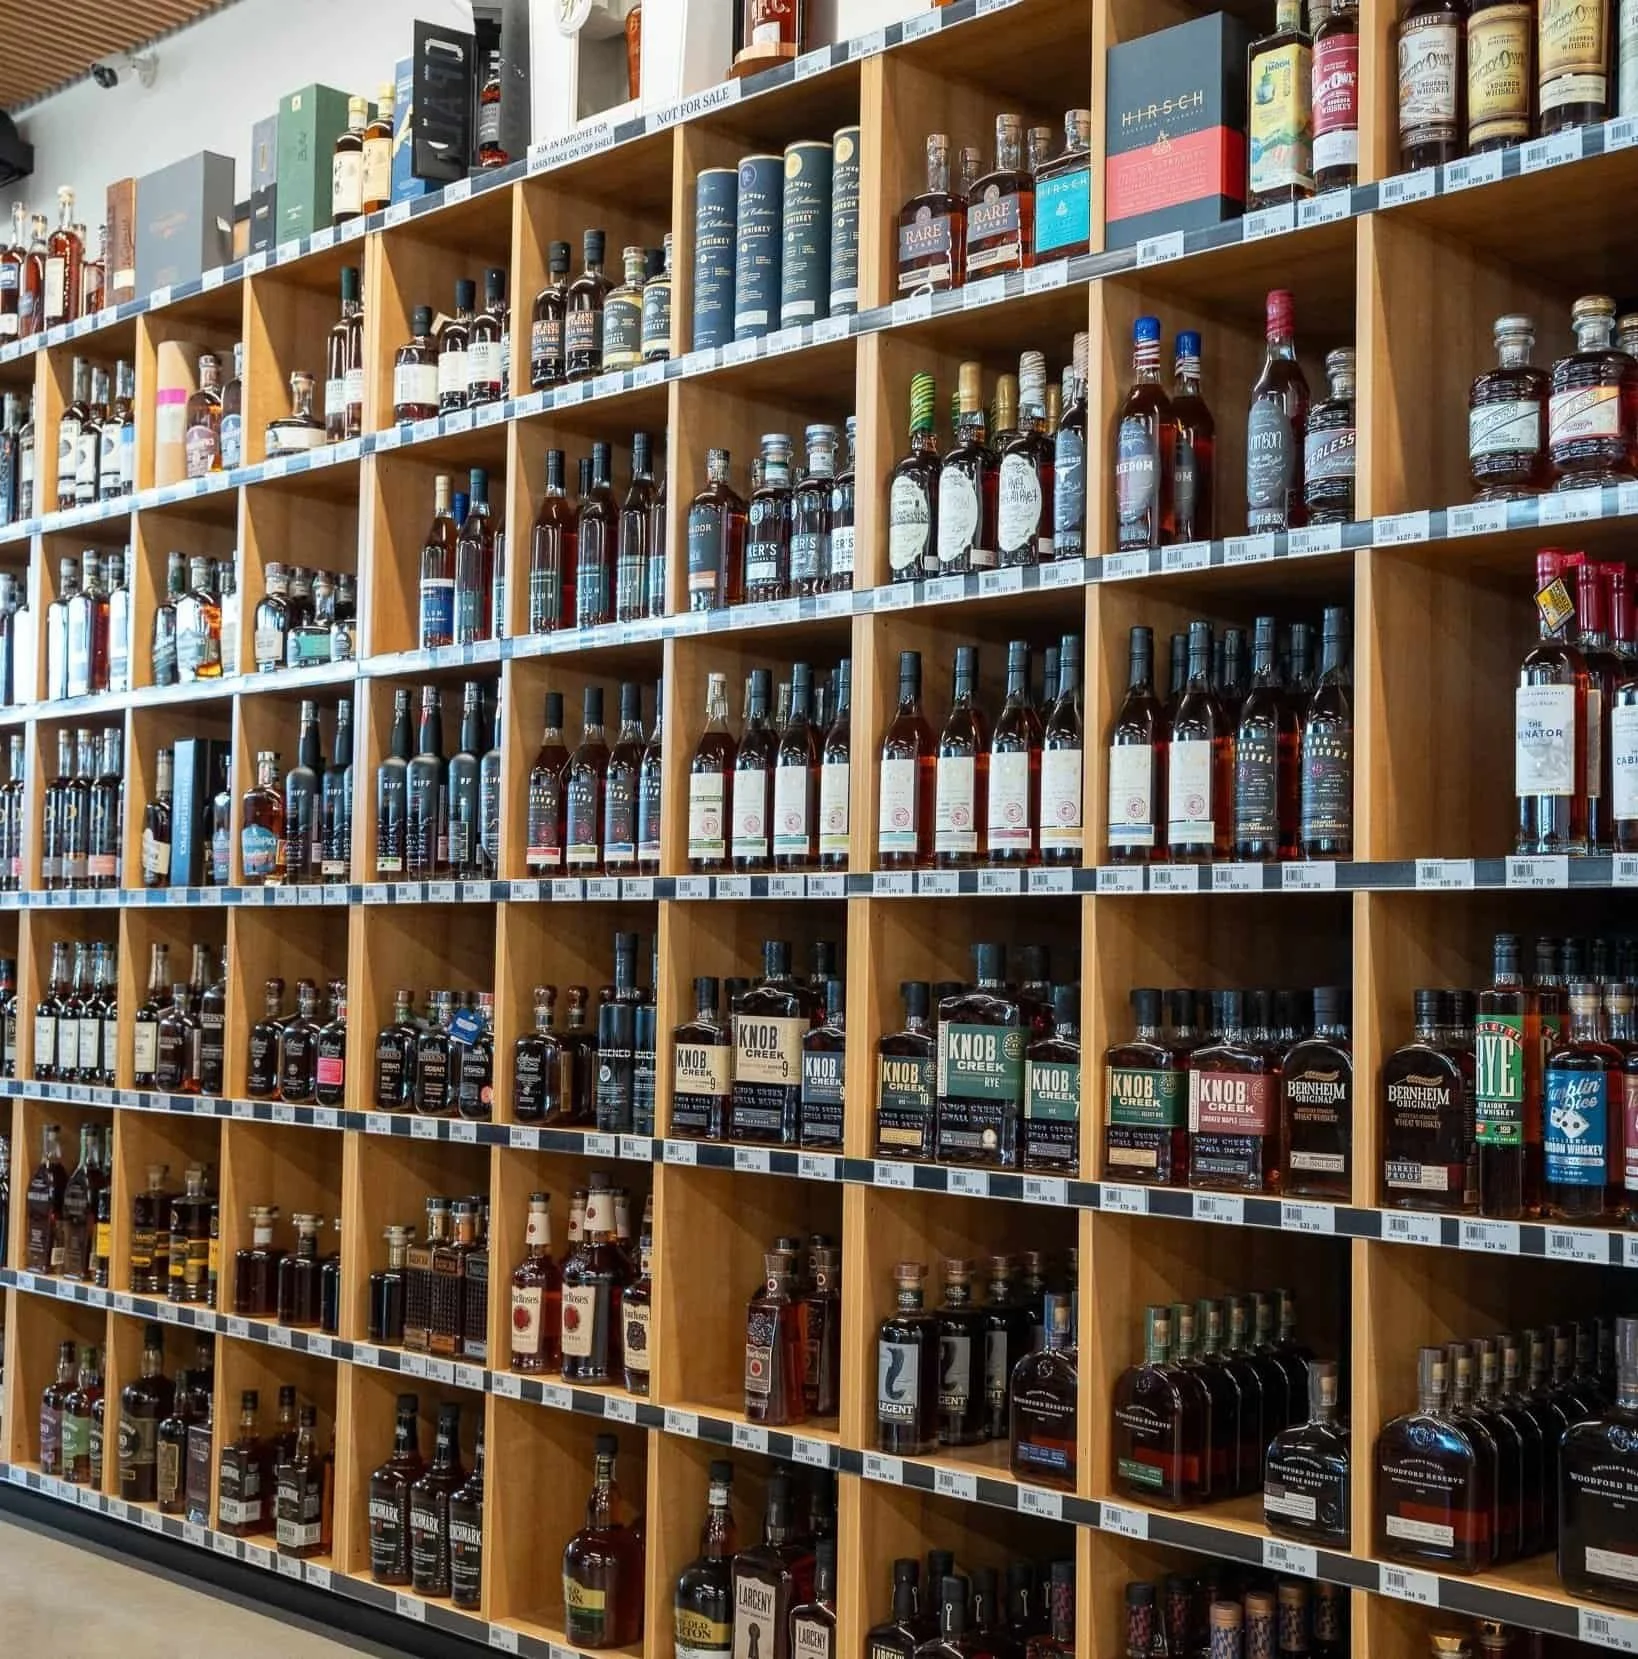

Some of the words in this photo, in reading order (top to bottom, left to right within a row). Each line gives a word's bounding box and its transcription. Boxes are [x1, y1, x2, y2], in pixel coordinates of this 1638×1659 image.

[1417, 86, 1449, 96] WHISKEY
[1485, 87, 1520, 97] WHISKEY
[656, 106, 677, 125] NOT
[679, 98, 701, 117] FOR
[702, 86, 729, 110] SALE
[1121, 90, 1203, 128] HIRSCH
[536, 143, 549, 153] ASK
[550, 139, 559, 149] AN
[560, 128, 593, 147] EMPLOYEE
[594, 123, 608, 136] FOR
[532, 154, 568, 170] ASSISTANCE
[569, 149, 580, 159] ON
[580, 144, 594, 157] TOP
[594, 136, 613, 152] SHELF
[1039, 176, 1089, 197] HIRSCH
[974, 200, 1011, 225] RARE
[702, 237, 729, 246] WHISKEY
[905, 224, 943, 245] RARE
[739, 1024, 778, 1050] KNOB
[745, 1049, 784, 1060] CREEK
[950, 1033, 996, 1061] KNOB
[678, 1049, 706, 1068] KNOB
[1476, 1036, 1515, 1097] RYE
[682, 1068, 712, 1077] CREEK
[782, 1061, 789, 1077] 9
[806, 1057, 836, 1077] KNOB
[883, 1061, 919, 1083] KNOB
[956, 1061, 1005, 1073] CREEK
[710, 1077, 716, 1090] 9
[810, 1076, 842, 1085] CREEK
[888, 1083, 927, 1091] CREEK
[984, 1076, 1000, 1088] RYE
[1032, 1068, 1069, 1091] KNOB
[1112, 1073, 1154, 1098] KNOB
[1038, 1091, 1077, 1101] CREEK
[1200, 1079, 1247, 1105] KNOB
[1287, 1081, 1346, 1100] BERNHEIM
[1389, 1085, 1450, 1105] BERNHEIM
[919, 1093, 929, 1105] 10
[1119, 1098, 1161, 1107] CREEK
[1295, 1094, 1334, 1104] ORIGINAL
[1396, 1100, 1438, 1110] ORIGINAL
[1207, 1103, 1254, 1113] CREEK
[1486, 1108, 1515, 1117] WHISKEY
[1221, 1116, 1237, 1125] MAPLE
[1567, 1144, 1603, 1155] WHISKEY
[1291, 1155, 1298, 1167] 7
[1387, 1164, 1420, 1173] BARREL
[1387, 1172, 1420, 1181] PROOF
[1382, 1465, 1424, 1478] WOODFORD
[1426, 1472, 1465, 1485] RESERVE
[1569, 1472, 1624, 1490] WOODFORD
[738, 1583, 773, 1615] LARCENY
[797, 1630, 826, 1650] LARCENY
